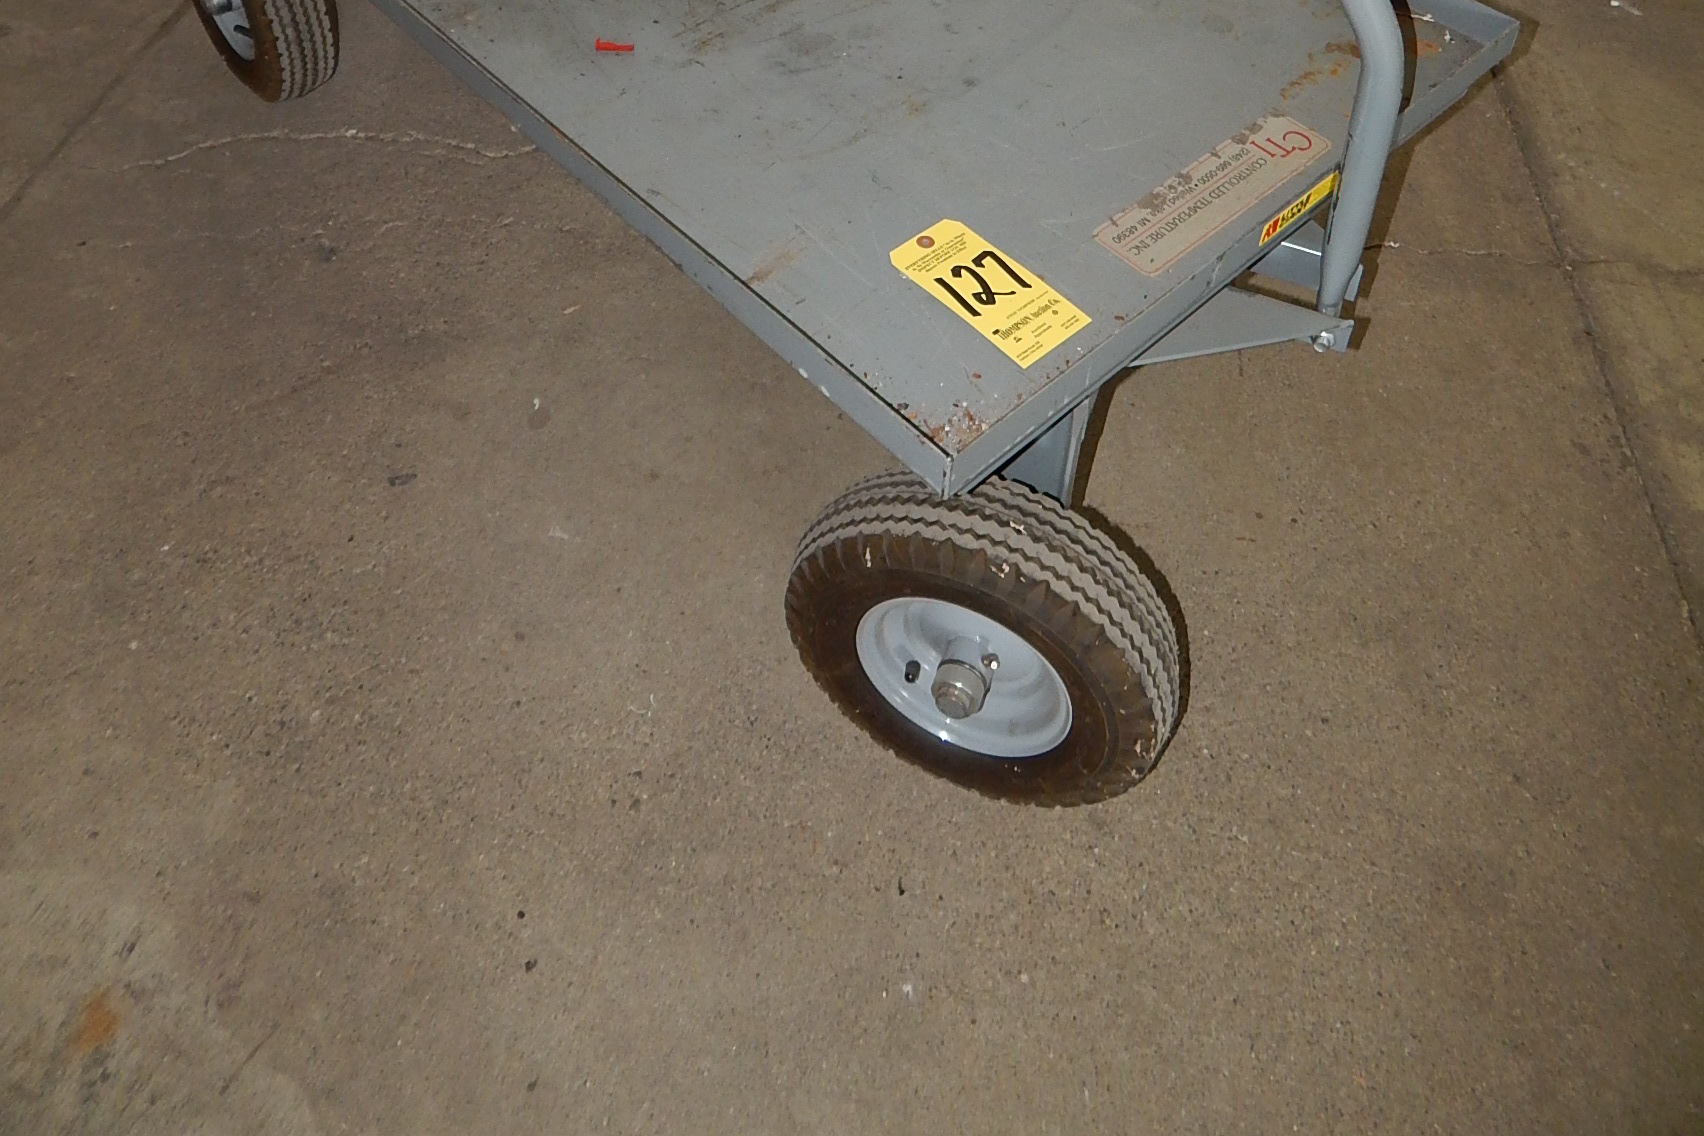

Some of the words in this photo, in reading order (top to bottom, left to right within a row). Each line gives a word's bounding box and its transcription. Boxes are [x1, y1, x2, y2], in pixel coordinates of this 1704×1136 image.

[1250, 130, 1312, 158] CTI
[1206, 156, 1269, 200] CONTROLLED
[1135, 216, 1150, 227] MI
[1144, 195, 1213, 244] TEMPERATURE
[1126, 239, 1151, 257] INC.
[933, 250, 1032, 317] 127
